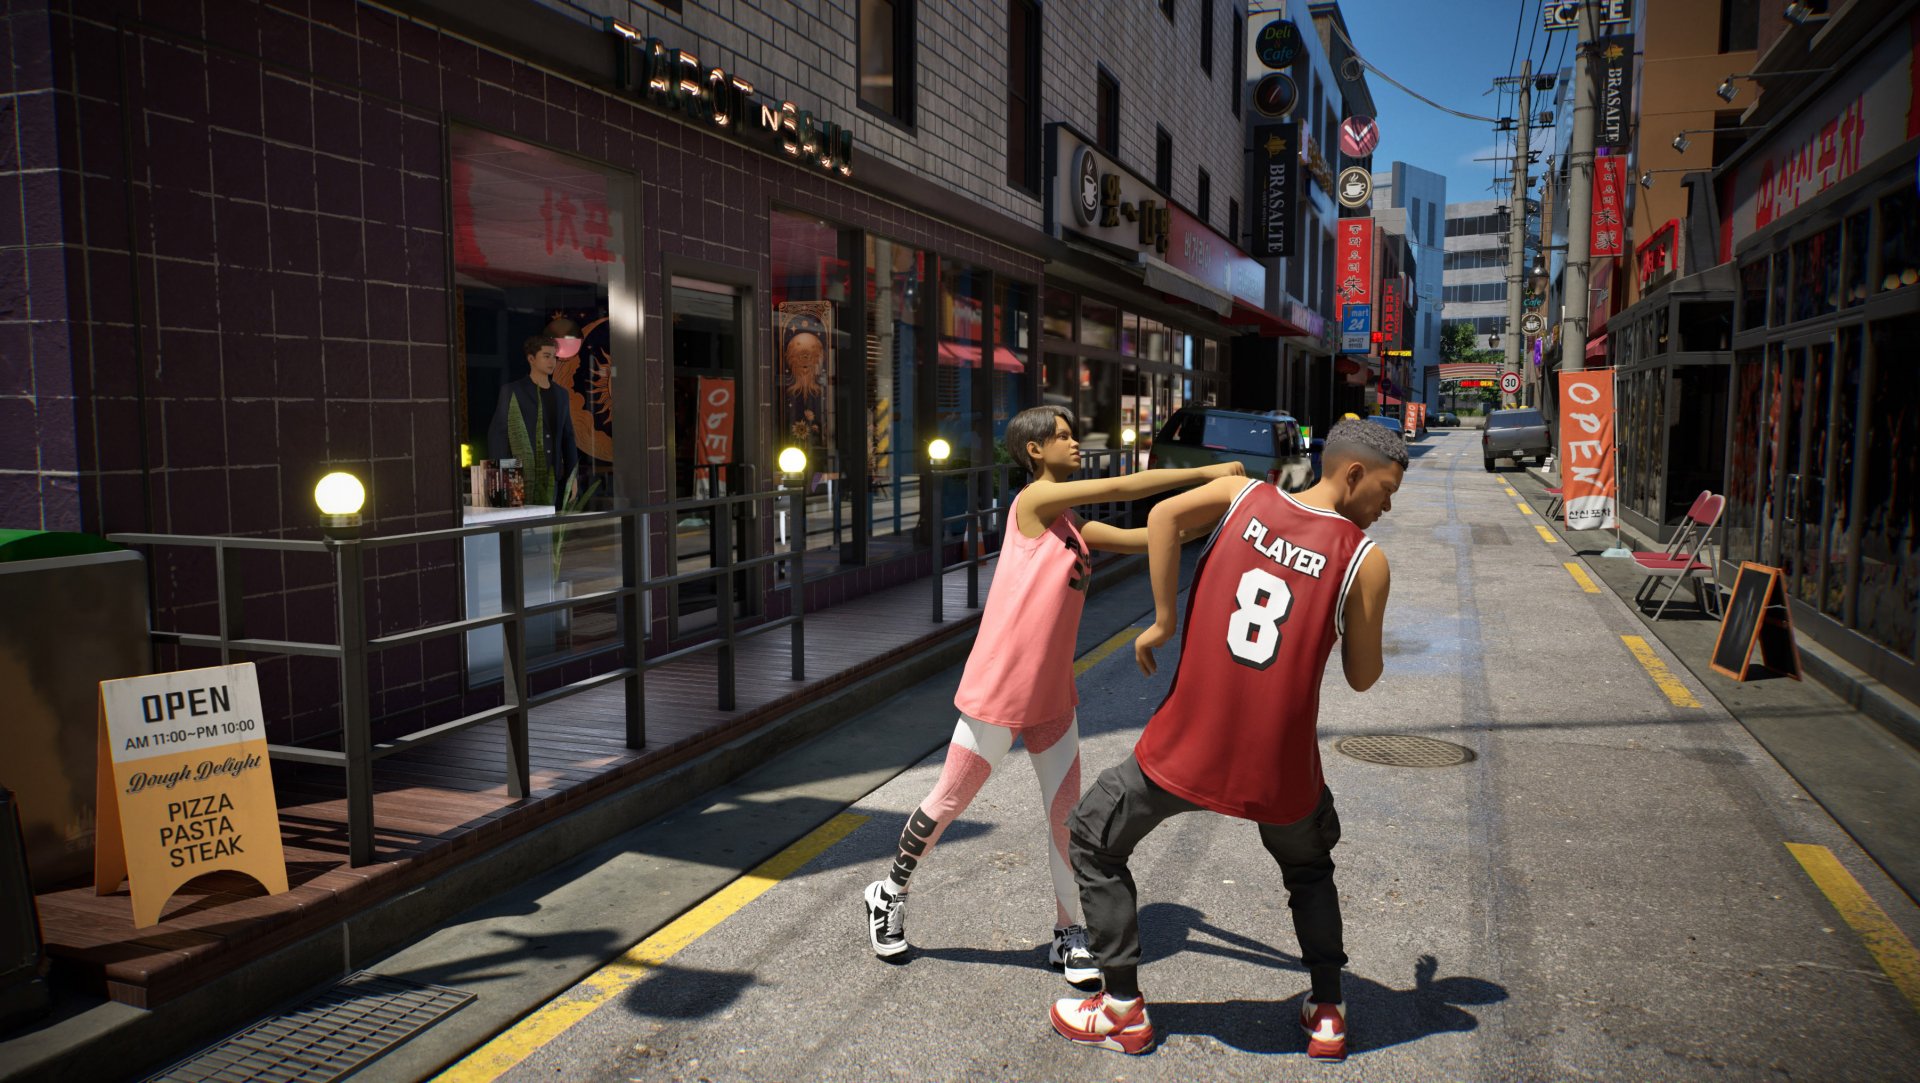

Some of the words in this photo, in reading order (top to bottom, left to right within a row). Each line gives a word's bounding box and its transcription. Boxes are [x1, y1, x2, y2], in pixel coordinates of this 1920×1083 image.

[1554, 0, 1624, 24] CE
[1265, 26, 1291, 40] Deli
[1263, 46, 1293, 62] Cafe
[603, 16, 754, 134] TAROT
[761, 103, 778, 132] N
[1606, 67, 1623, 143] BRASALTE
[1268, 163, 1286, 254] BRASALTE
[1347, 224, 1363, 274] 중화요리
[1523, 298, 1542, 307] Cafe
[1348, 318, 1365, 331] 24
[1504, 378, 1516, 389] 30
[1568, 382, 1604, 491] OPEN
[1242, 516, 1328, 579] PLAYER
[1227, 567, 1295, 671] 8
[142, 685, 231, 724] OPEN
[125, 734, 149, 751] AM
[222, 719, 255, 735] 10:00
[126, 764, 192, 794] Dough
[193, 753, 261, 781] Delight
[168, 793, 234, 822] PIZZA
[160, 815, 234, 847] PASTA
[890, 806, 938, 887] DASH
[170, 835, 244, 868] STEAK
